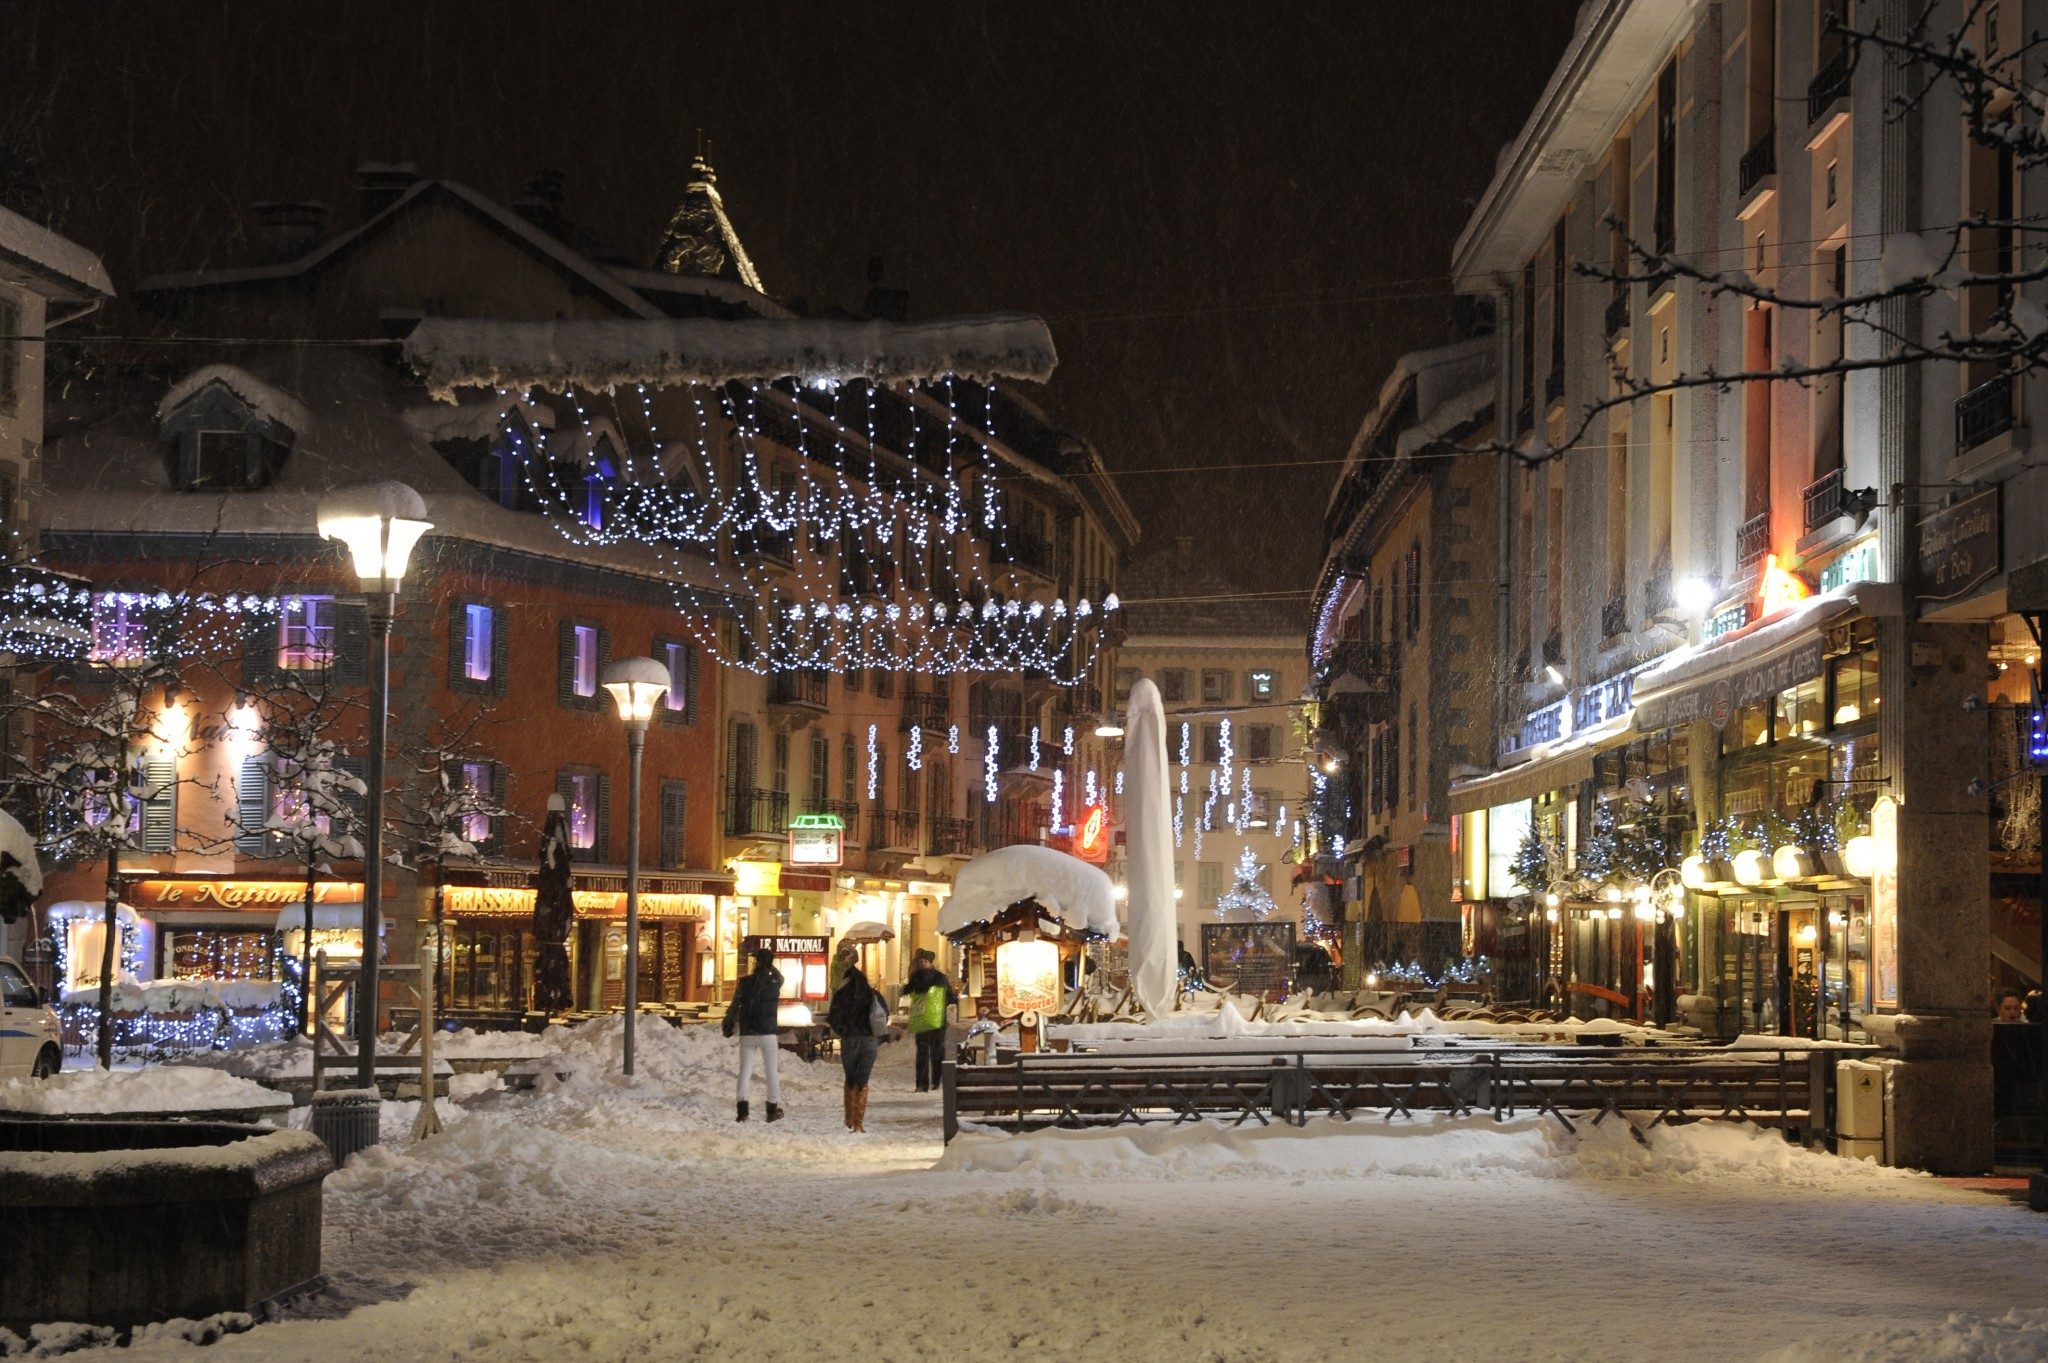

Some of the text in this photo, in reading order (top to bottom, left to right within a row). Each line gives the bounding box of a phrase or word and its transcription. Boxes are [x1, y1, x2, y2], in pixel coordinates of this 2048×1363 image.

[157, 884, 182, 901] le
[586, 877, 624, 892] NATIONAL
[661, 880, 704, 894] RESTAURANT
[451, 889, 538, 912] BRASSERIE
[639, 896, 707, 917] ESTAURANT
[775, 938, 824, 953] NATIONAL
